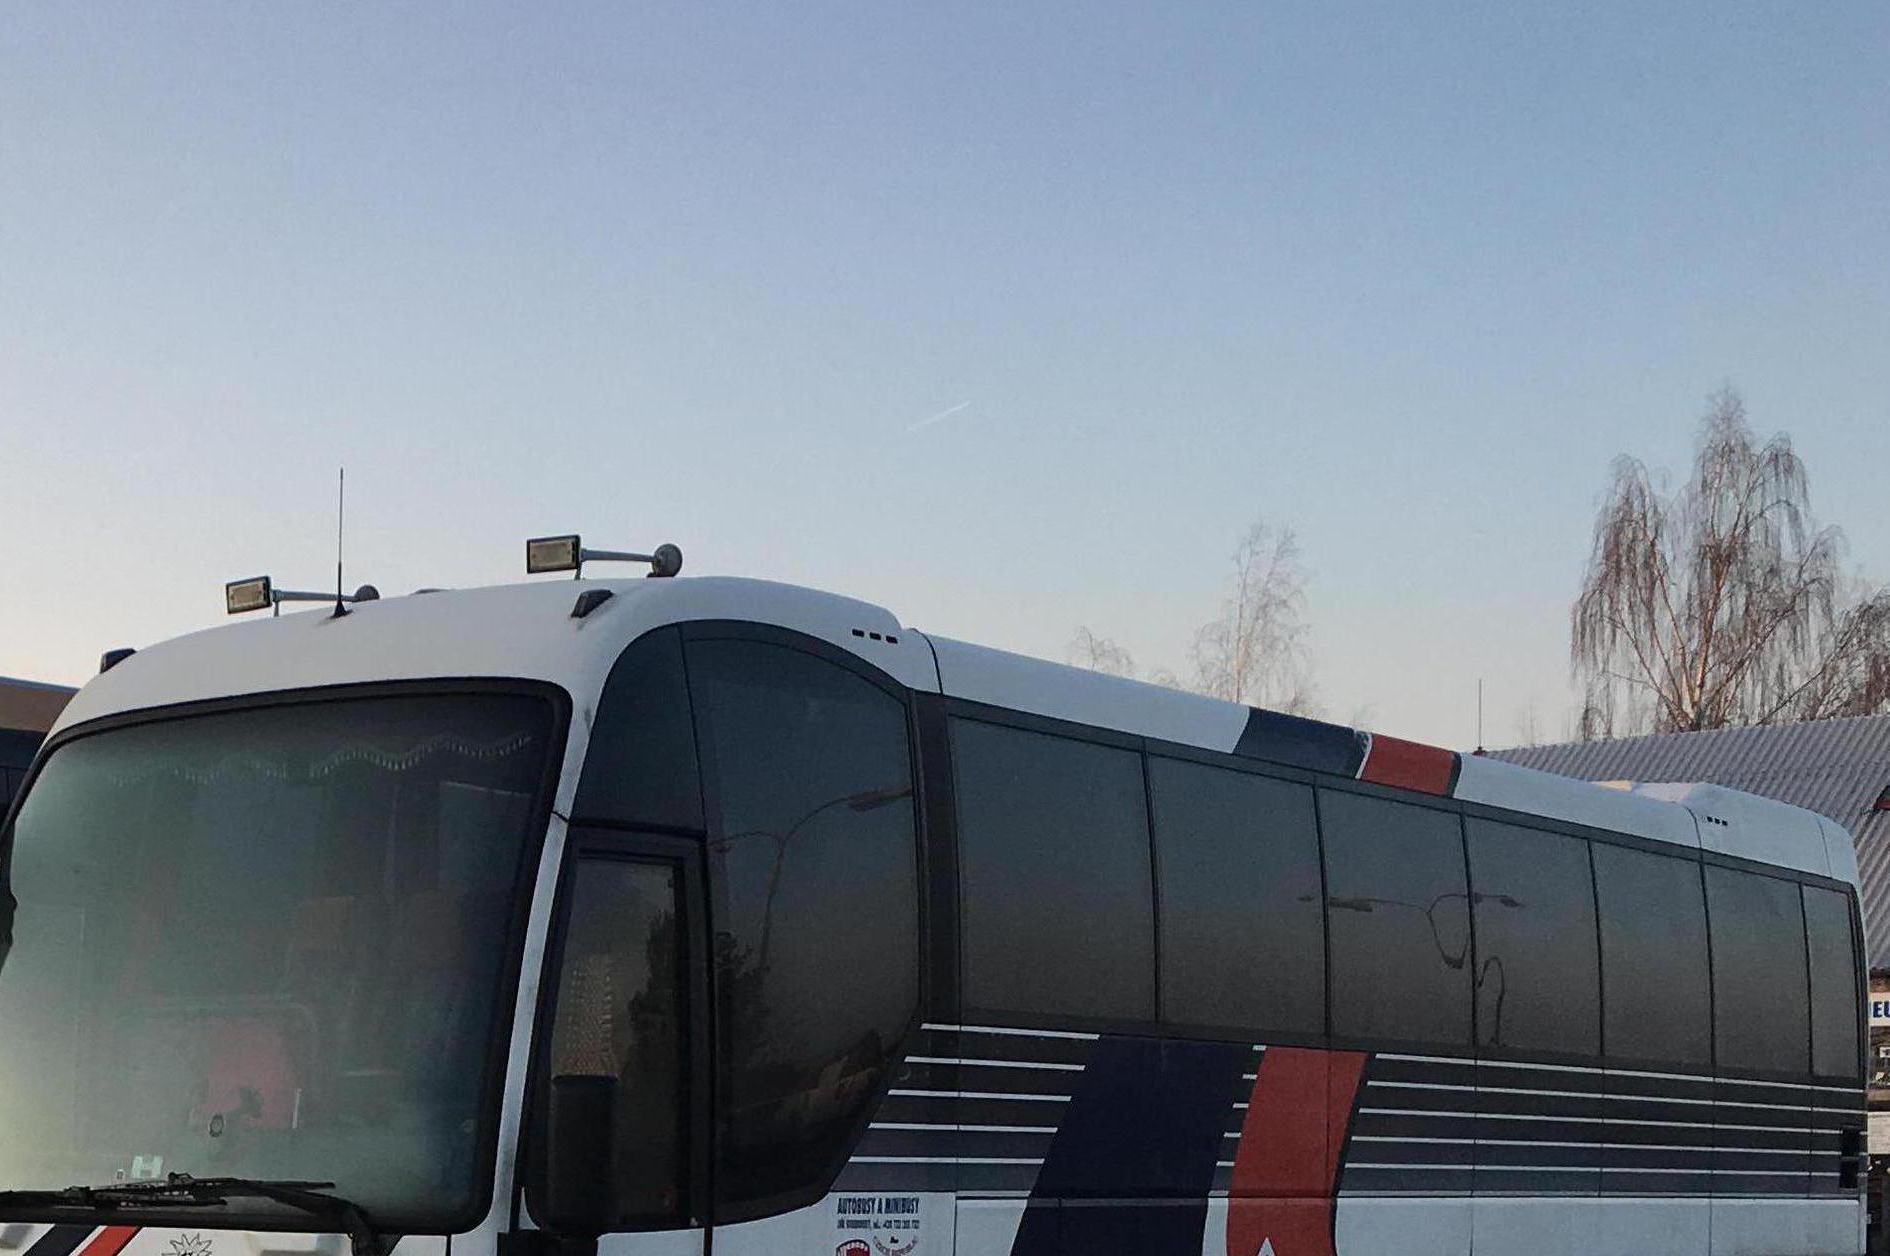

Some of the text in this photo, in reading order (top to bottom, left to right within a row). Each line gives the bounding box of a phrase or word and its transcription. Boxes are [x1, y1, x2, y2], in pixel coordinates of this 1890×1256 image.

[837, 1198, 919, 1214] AUTOBUSY A MINIBUSY
